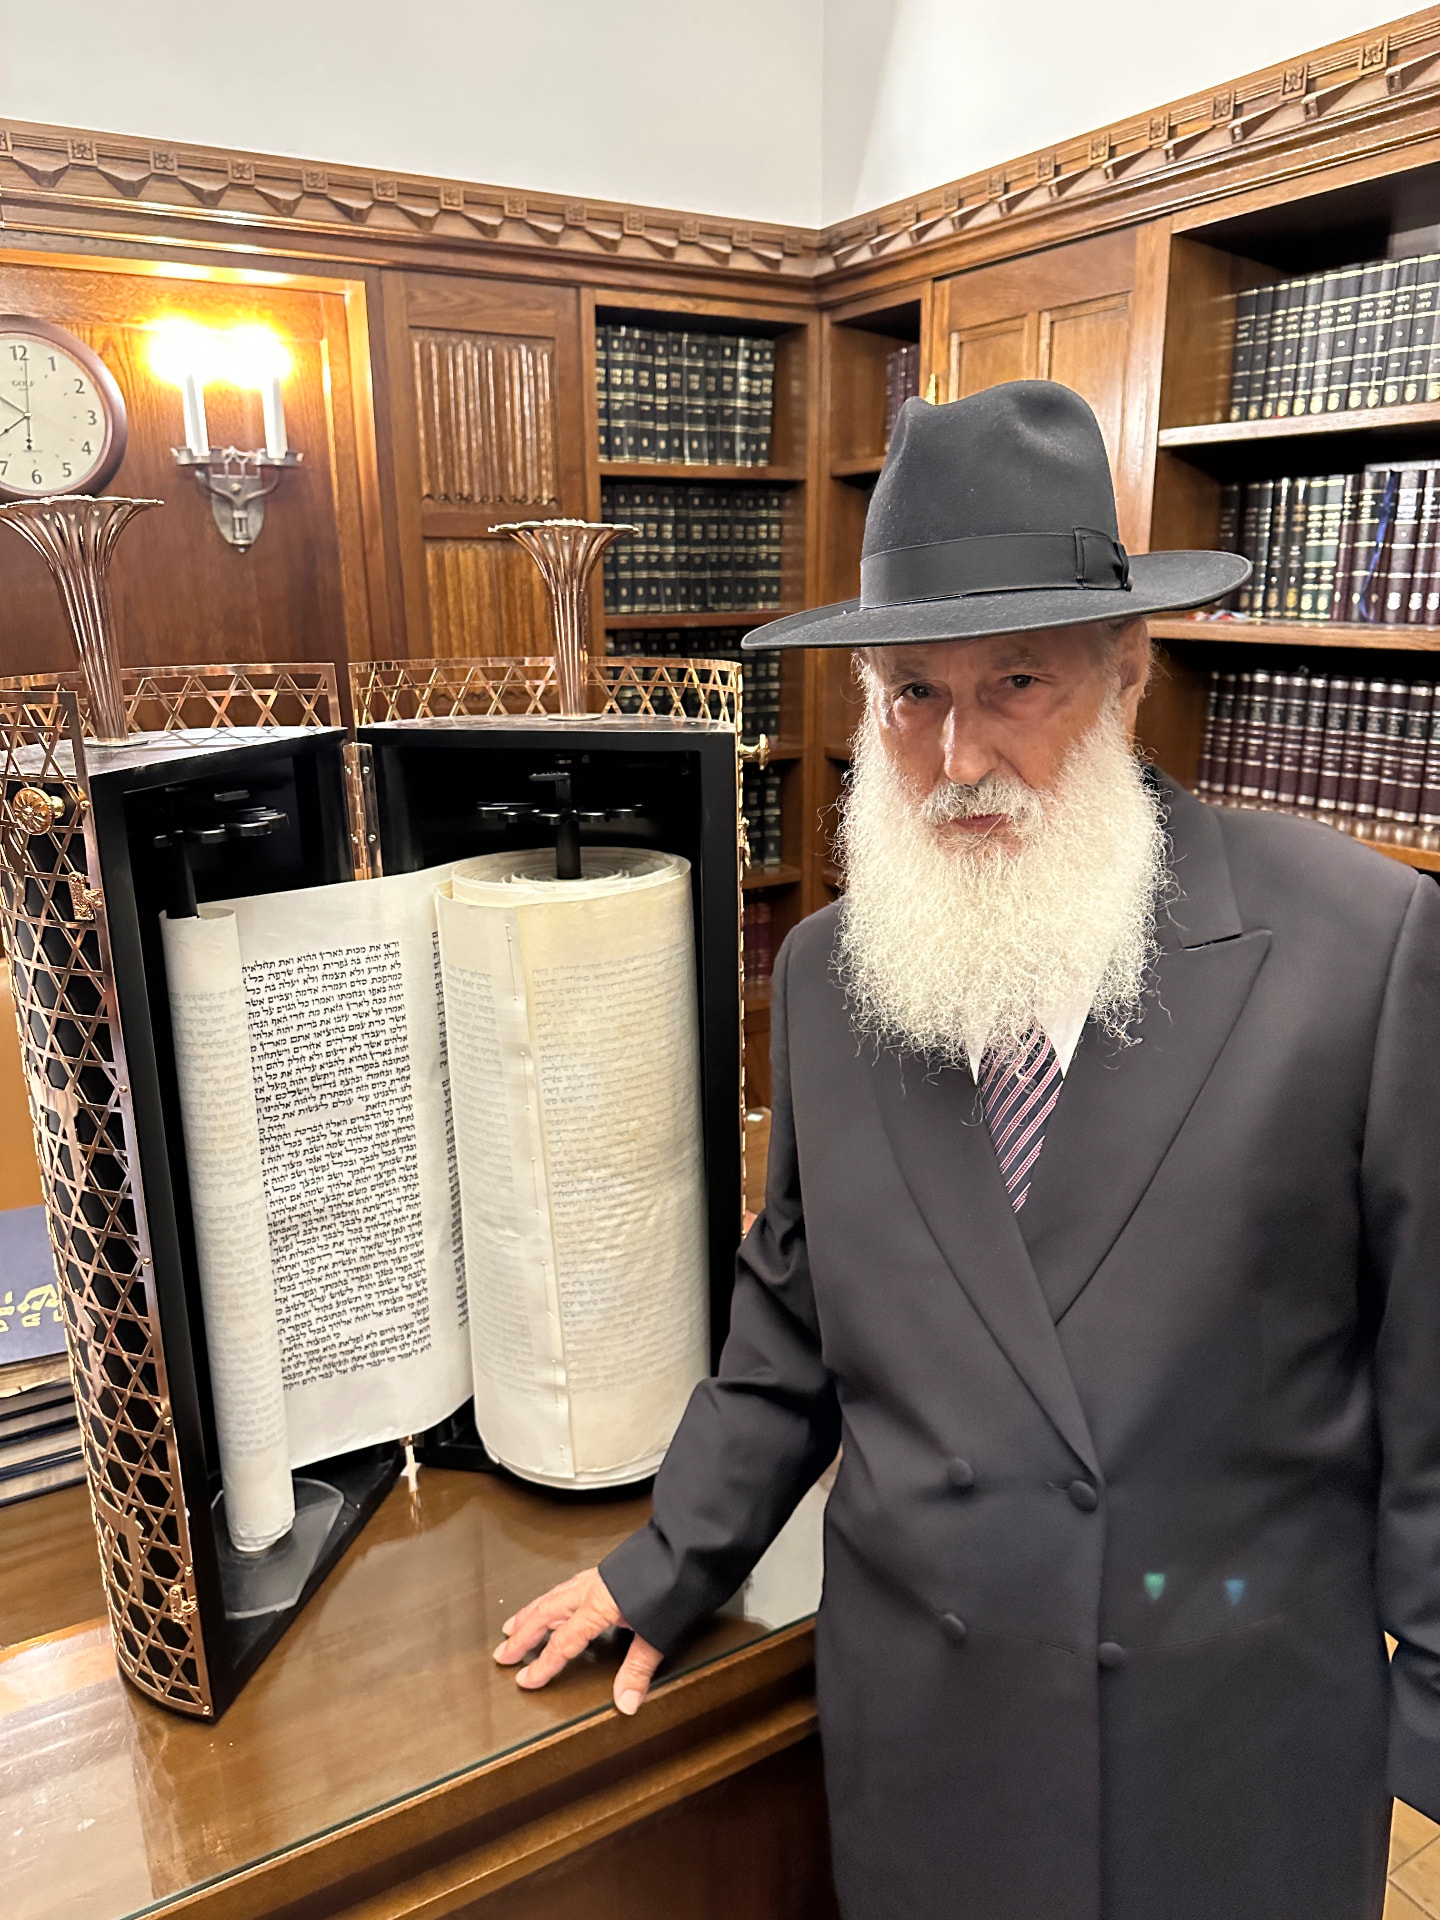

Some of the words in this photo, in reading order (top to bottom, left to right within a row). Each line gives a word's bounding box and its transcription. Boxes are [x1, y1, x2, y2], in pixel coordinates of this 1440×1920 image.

[9, 345, 29, 360] 12
[48, 356, 56, 371] 1
[74, 378, 85, 394] 2
[87, 409, 97, 425] 3
[81, 440, 92, 455] 4
[0, 460, 8, 476] 7
[62, 462, 72, 477] 5
[31, 469, 42, 485] 6
[369, 943, 380, 952] את
[383, 941, 399, 949] וראו
[319, 948, 343, 960] הארץ
[345, 946, 366, 955] מכות
[384, 950, 399, 960] חלה
[278, 957, 294, 967] ואת
[296, 952, 316, 963] ההוא
[350, 956, 361, 965] בה
[365, 954, 381, 963] יהוה
[296, 963, 318, 973] ומלח
[322, 958, 348, 970] גפרית
[367, 964, 386, 974] תזרע
[390, 959, 401, 970] לא
[267, 968, 293, 980] שרפה
[321, 971, 346, 980] תצמח
[349, 966, 364, 976] ולא
[248, 973, 264, 982] כל
[302, 973, 318, 985] ולא
[349, 978, 367, 987] סדם
[264, 983, 276, 992] בה
[278, 978, 299, 989] יעלה
[321, 982, 347, 992] ועמרה
[388, 983, 402, 991] יהוה
[245, 985, 260, 994] כל
[295, 986, 318, 997] אדמה
[368, 986, 386, 996] באפו
[311, 995, 334, 1005] ואמרו
[388, 993, 403, 1001] יהוה
[276, 1001, 296, 1013] הגוים
[296, 998, 309, 1007] כל
[346, 997, 369, 1010] לארץ
[261, 1005, 274, 1015] על
[308, 1009, 320, 1017] מה
[323, 1003, 343, 1014] הזאת
[371, 1006, 382, 1015] על
[384, 1003, 404, 1013] ואמרו
[247, 1010, 260, 1019] מה
[289, 1011, 304, 1019] חרי
[333, 1013, 349, 1022] עזבו
[352, 1010, 370, 1018] אשר
[388, 1013, 405, 1022] אשר
[247, 1019, 268, 1030] הגדו
[271, 1013, 287, 1026] האף
[319, 1017, 330, 1026] את
[368, 1018, 385, 1027] כרת
[276, 1025, 293, 1035] יהוה
[296, 1019, 317, 1031] ברית
[348, 1021, 365, 1031] עמם
[389, 1023, 406, 1033] וילכו
[252, 1029, 273, 1040] אלהי
[289, 1032, 310, 1043] אתם
[384, 1033, 407, 1045] אלהים
[259, 1038, 286, 1051] מארץ
[325, 1033, 357, 1047] אלהים
[363, 1040, 381, 1049] אשר
[293, 1041, 321, 1053] אחרים
[325, 1047, 347, 1057] ידעום
[349, 1042, 361, 1053] לא
[394, 1044, 408, 1053] יהוה
[308, 1050, 323, 1061] ולא
[348, 1052, 367, 1063] ההוא
[368, 1047, 391, 1060] בארץ
[265, 1057, 284, 1070] להם
[287, 1054, 305, 1067] חלק
[319, 1056, 344, 1070] להביא
[355, 1059, 379, 1071] בספר
[280, 1069, 292, 1078] את
[295, 1063, 316, 1074] עליה
[337, 1066, 352, 1076] הזה
[264, 1071, 277, 1080] כל
[289, 1075, 307, 1086] יהוה
[310, 1071, 335, 1082] ויתשם
[266, 1081, 286, 1090] מעל
